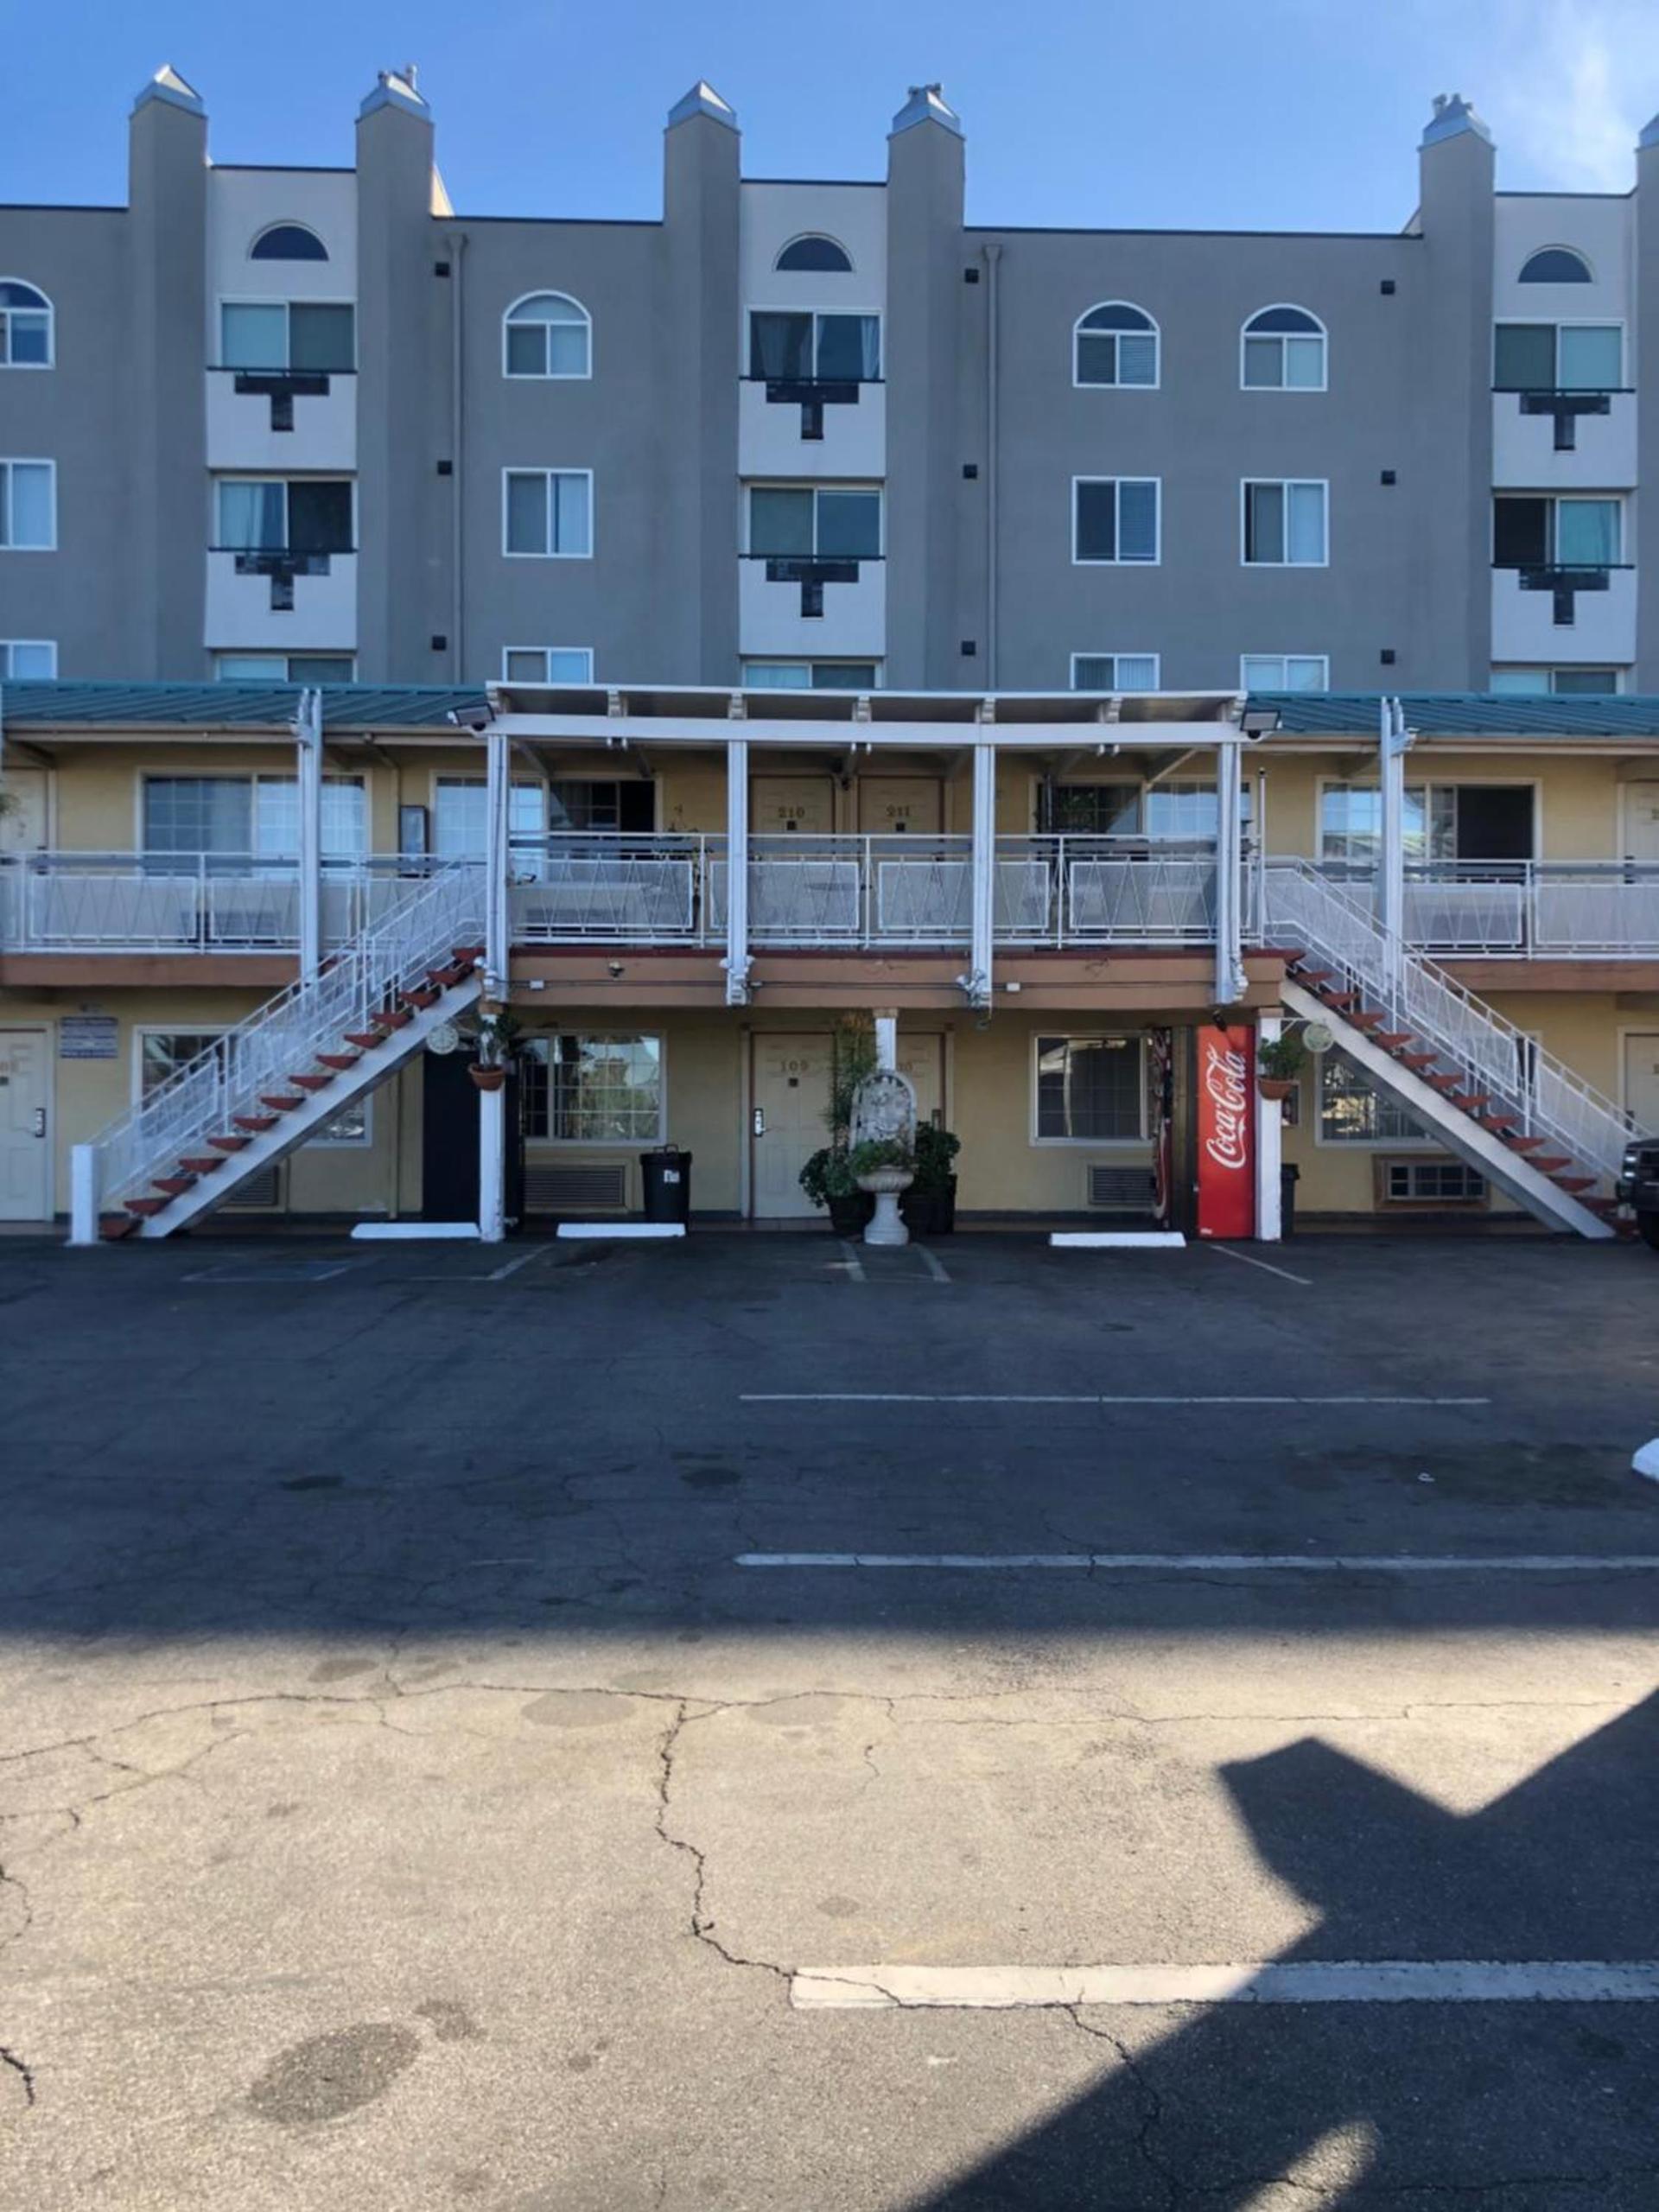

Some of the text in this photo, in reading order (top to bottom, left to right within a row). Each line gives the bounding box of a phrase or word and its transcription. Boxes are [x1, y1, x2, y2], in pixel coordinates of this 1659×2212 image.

[778, 806, 805, 818] 210
[886, 804, 911, 817] 211
[1206, 1042, 1247, 1169] Coca-Cola
